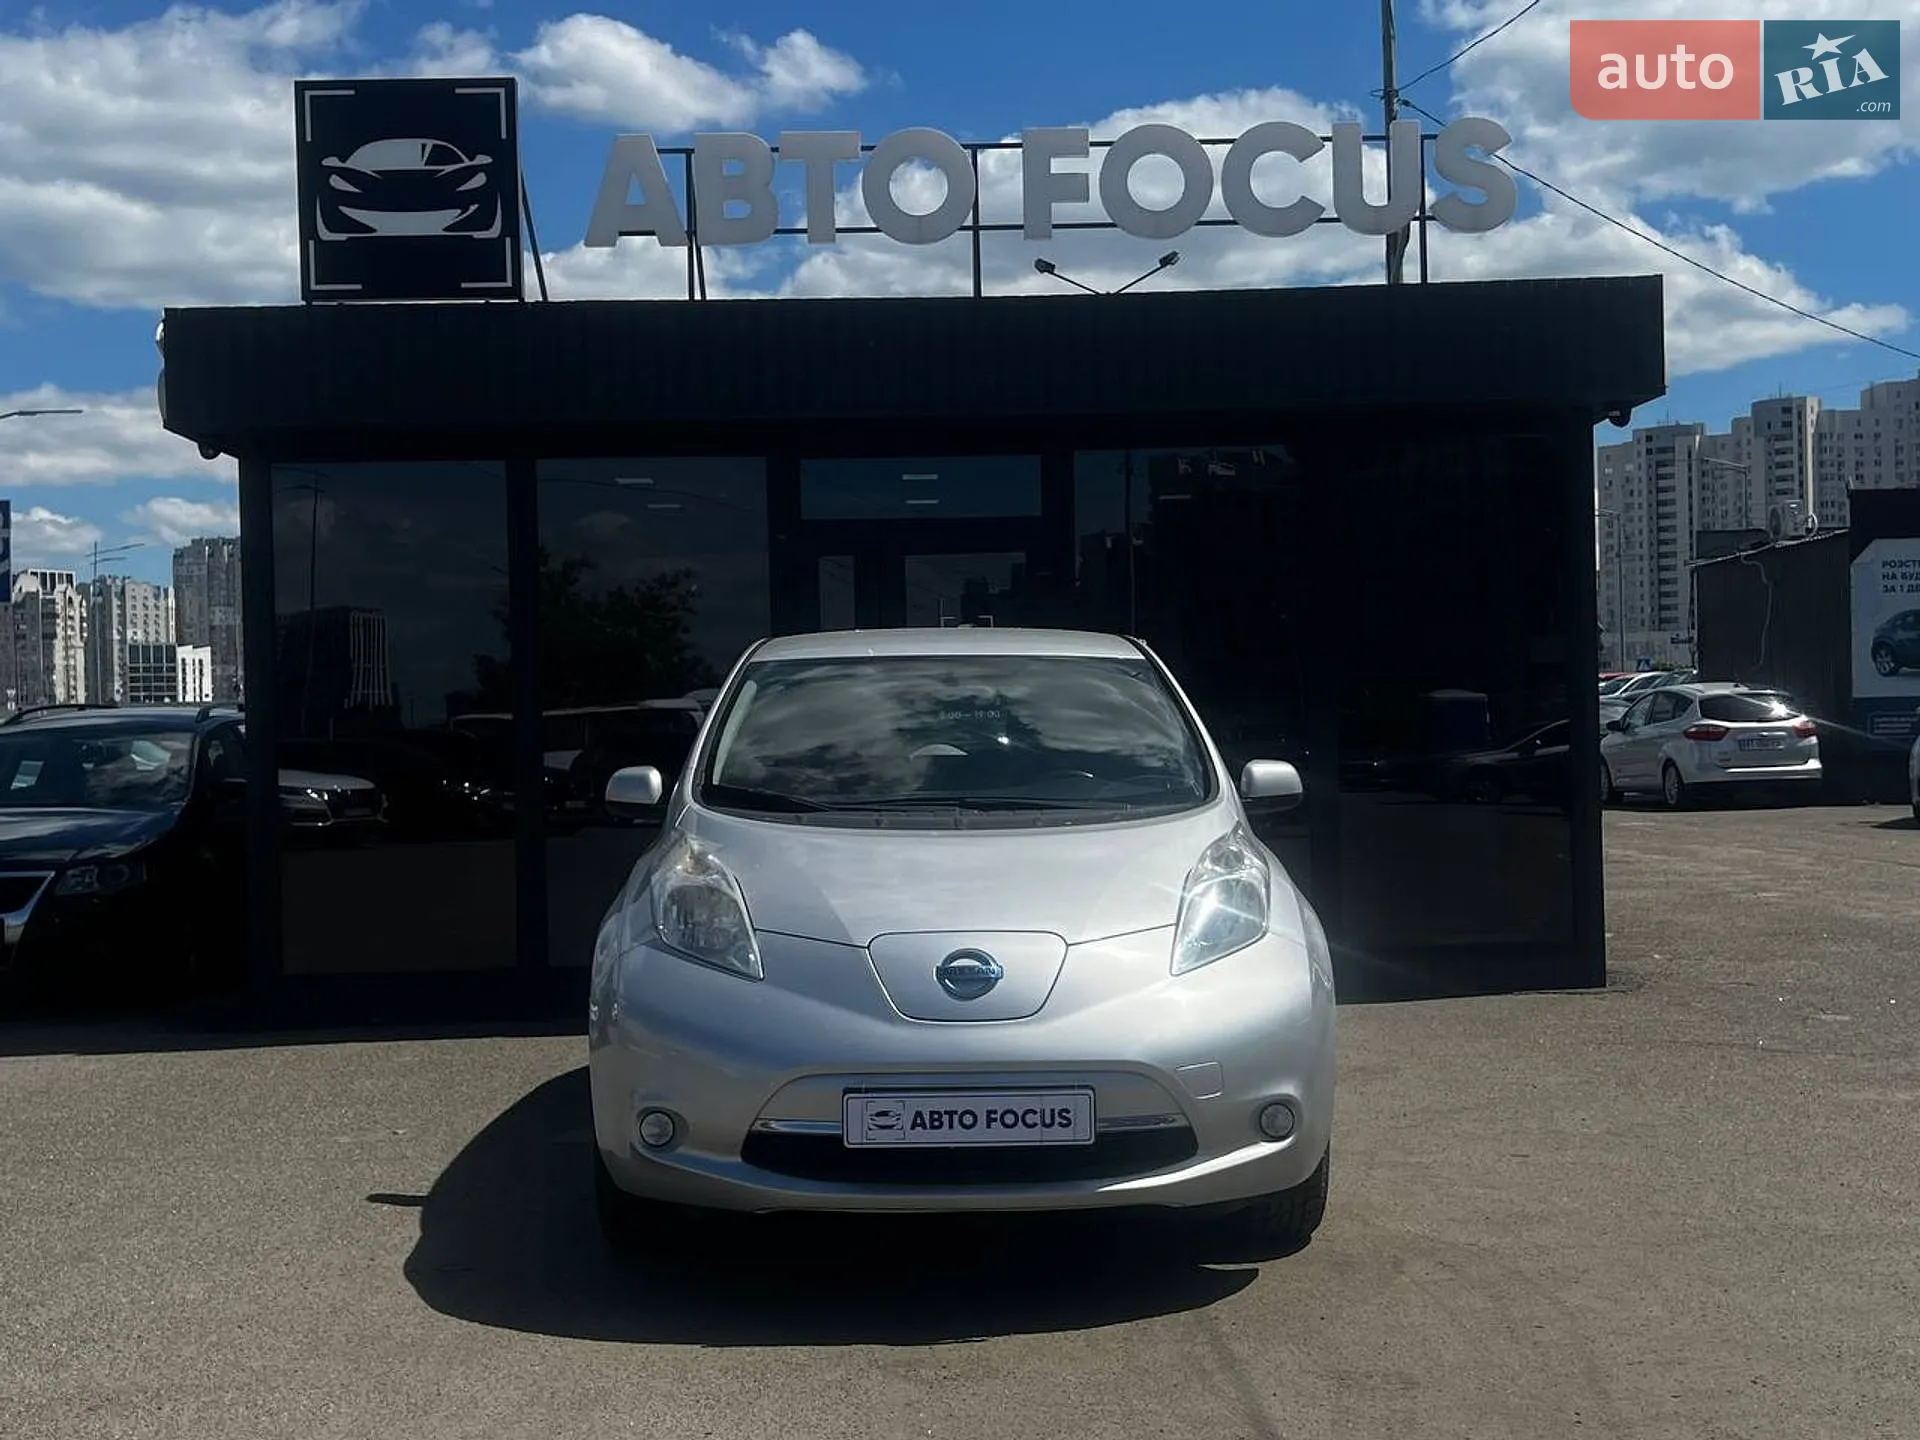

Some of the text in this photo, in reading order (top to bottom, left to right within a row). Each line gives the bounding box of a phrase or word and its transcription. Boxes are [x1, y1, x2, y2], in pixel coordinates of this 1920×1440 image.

[583, 116, 1518, 247] АВТО FOCUS
[1882, 560, 1920, 569] РОЗСТ
[910, 1107, 1073, 1131] АВТО FOCUS
